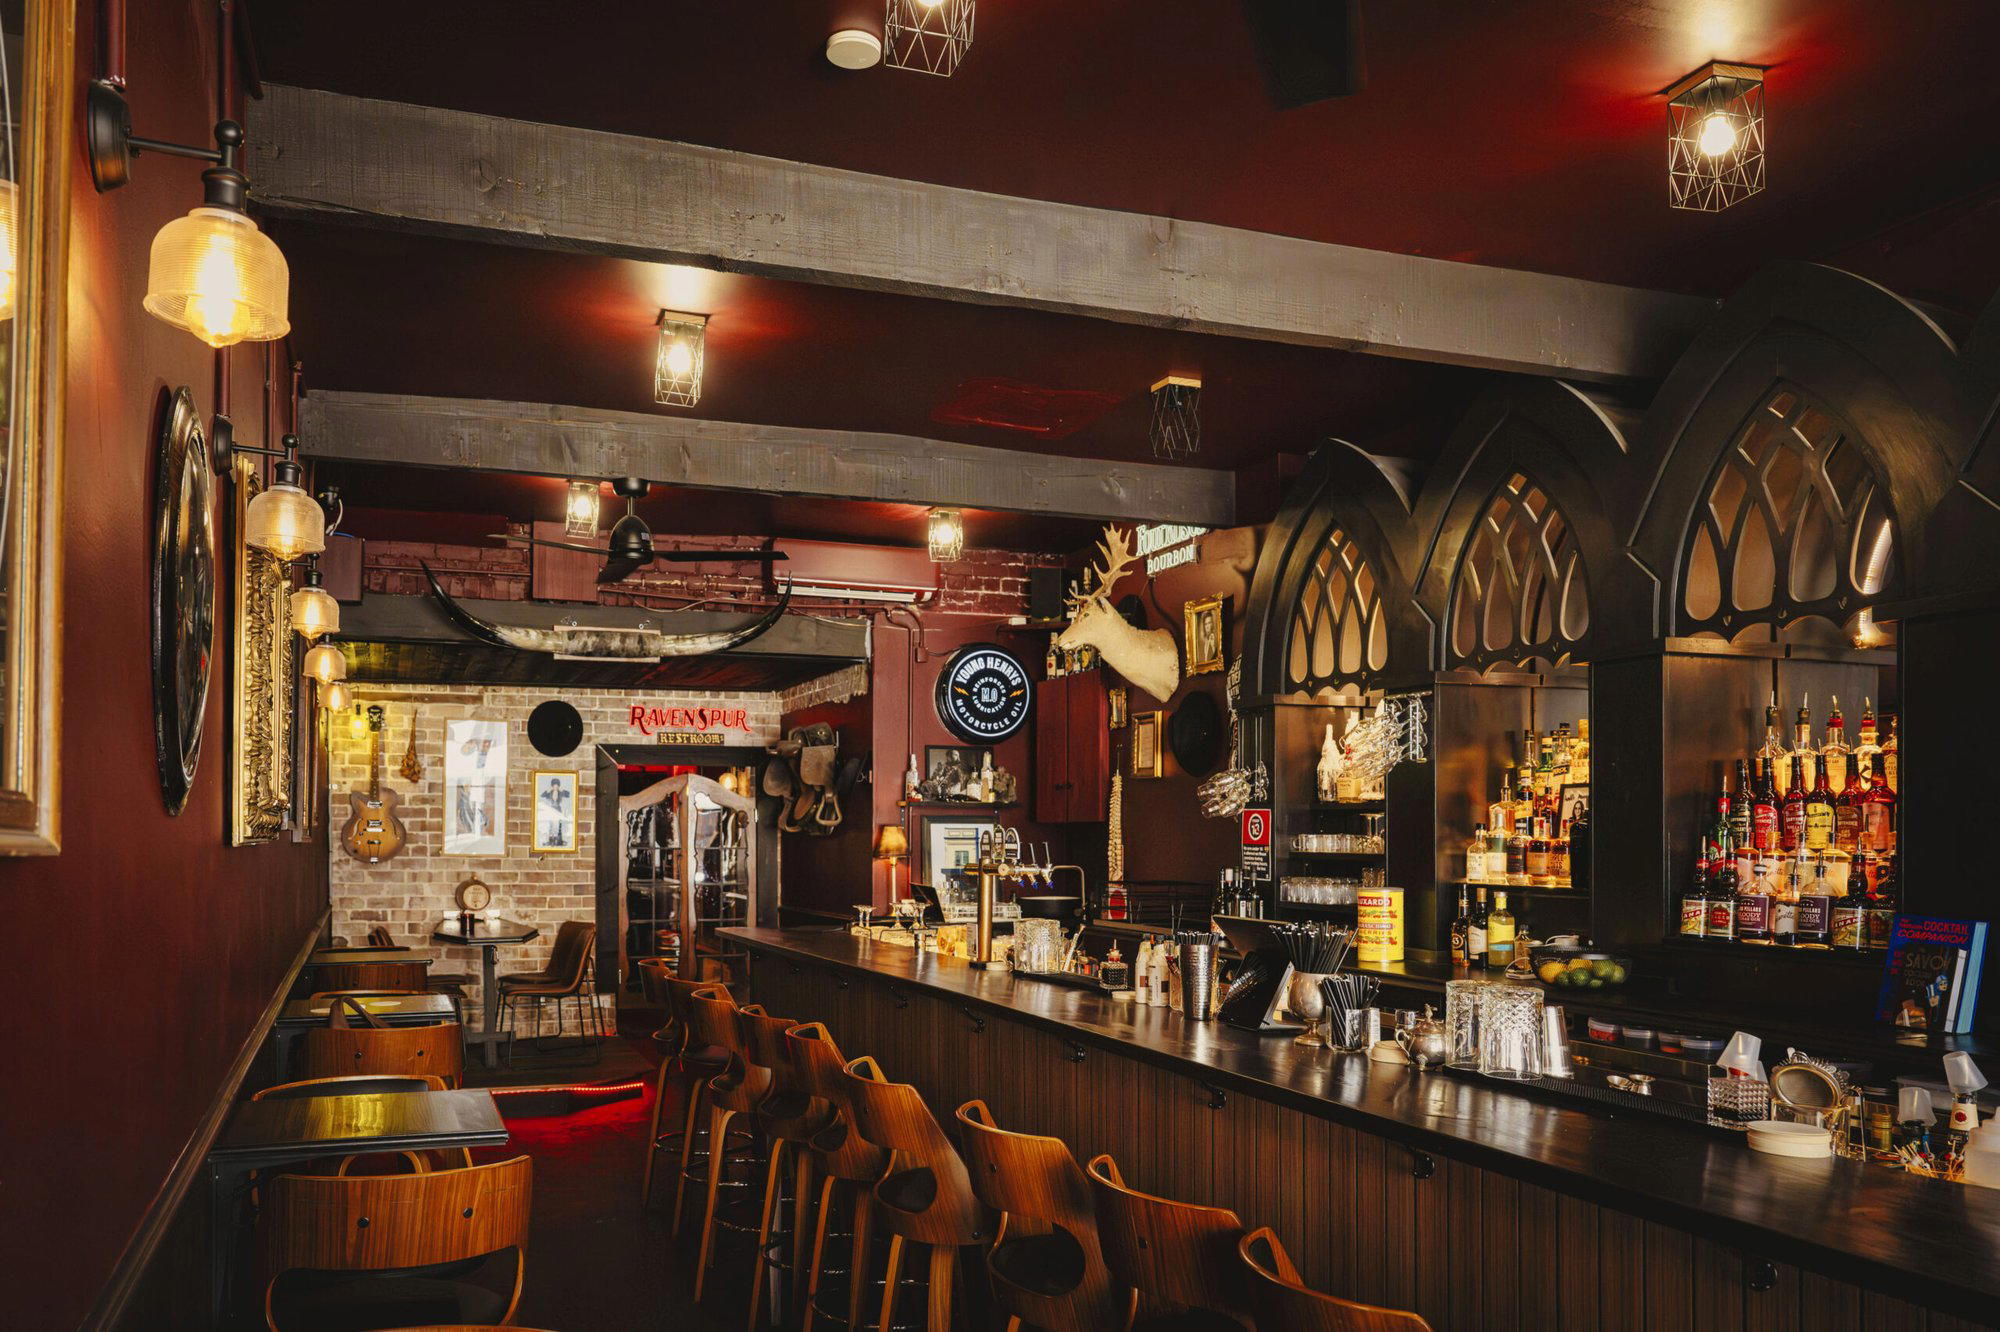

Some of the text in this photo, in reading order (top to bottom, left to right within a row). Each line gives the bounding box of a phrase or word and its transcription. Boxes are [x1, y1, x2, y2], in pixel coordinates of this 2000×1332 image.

[1147, 544, 1196, 575] BOURBON
[955, 657, 1022, 686] YOUNG HENRYS
[972, 677, 1006, 693] REINFORCES
[972, 695, 1006, 714] LUBRICATION
[956, 699, 1022, 730] MOTORCYCLE OIL
[1897, 929, 1969, 945] COMPANION
[1923, 921, 1969, 936] COCKTAIL
[1906, 953, 1952, 970] SAVOY
